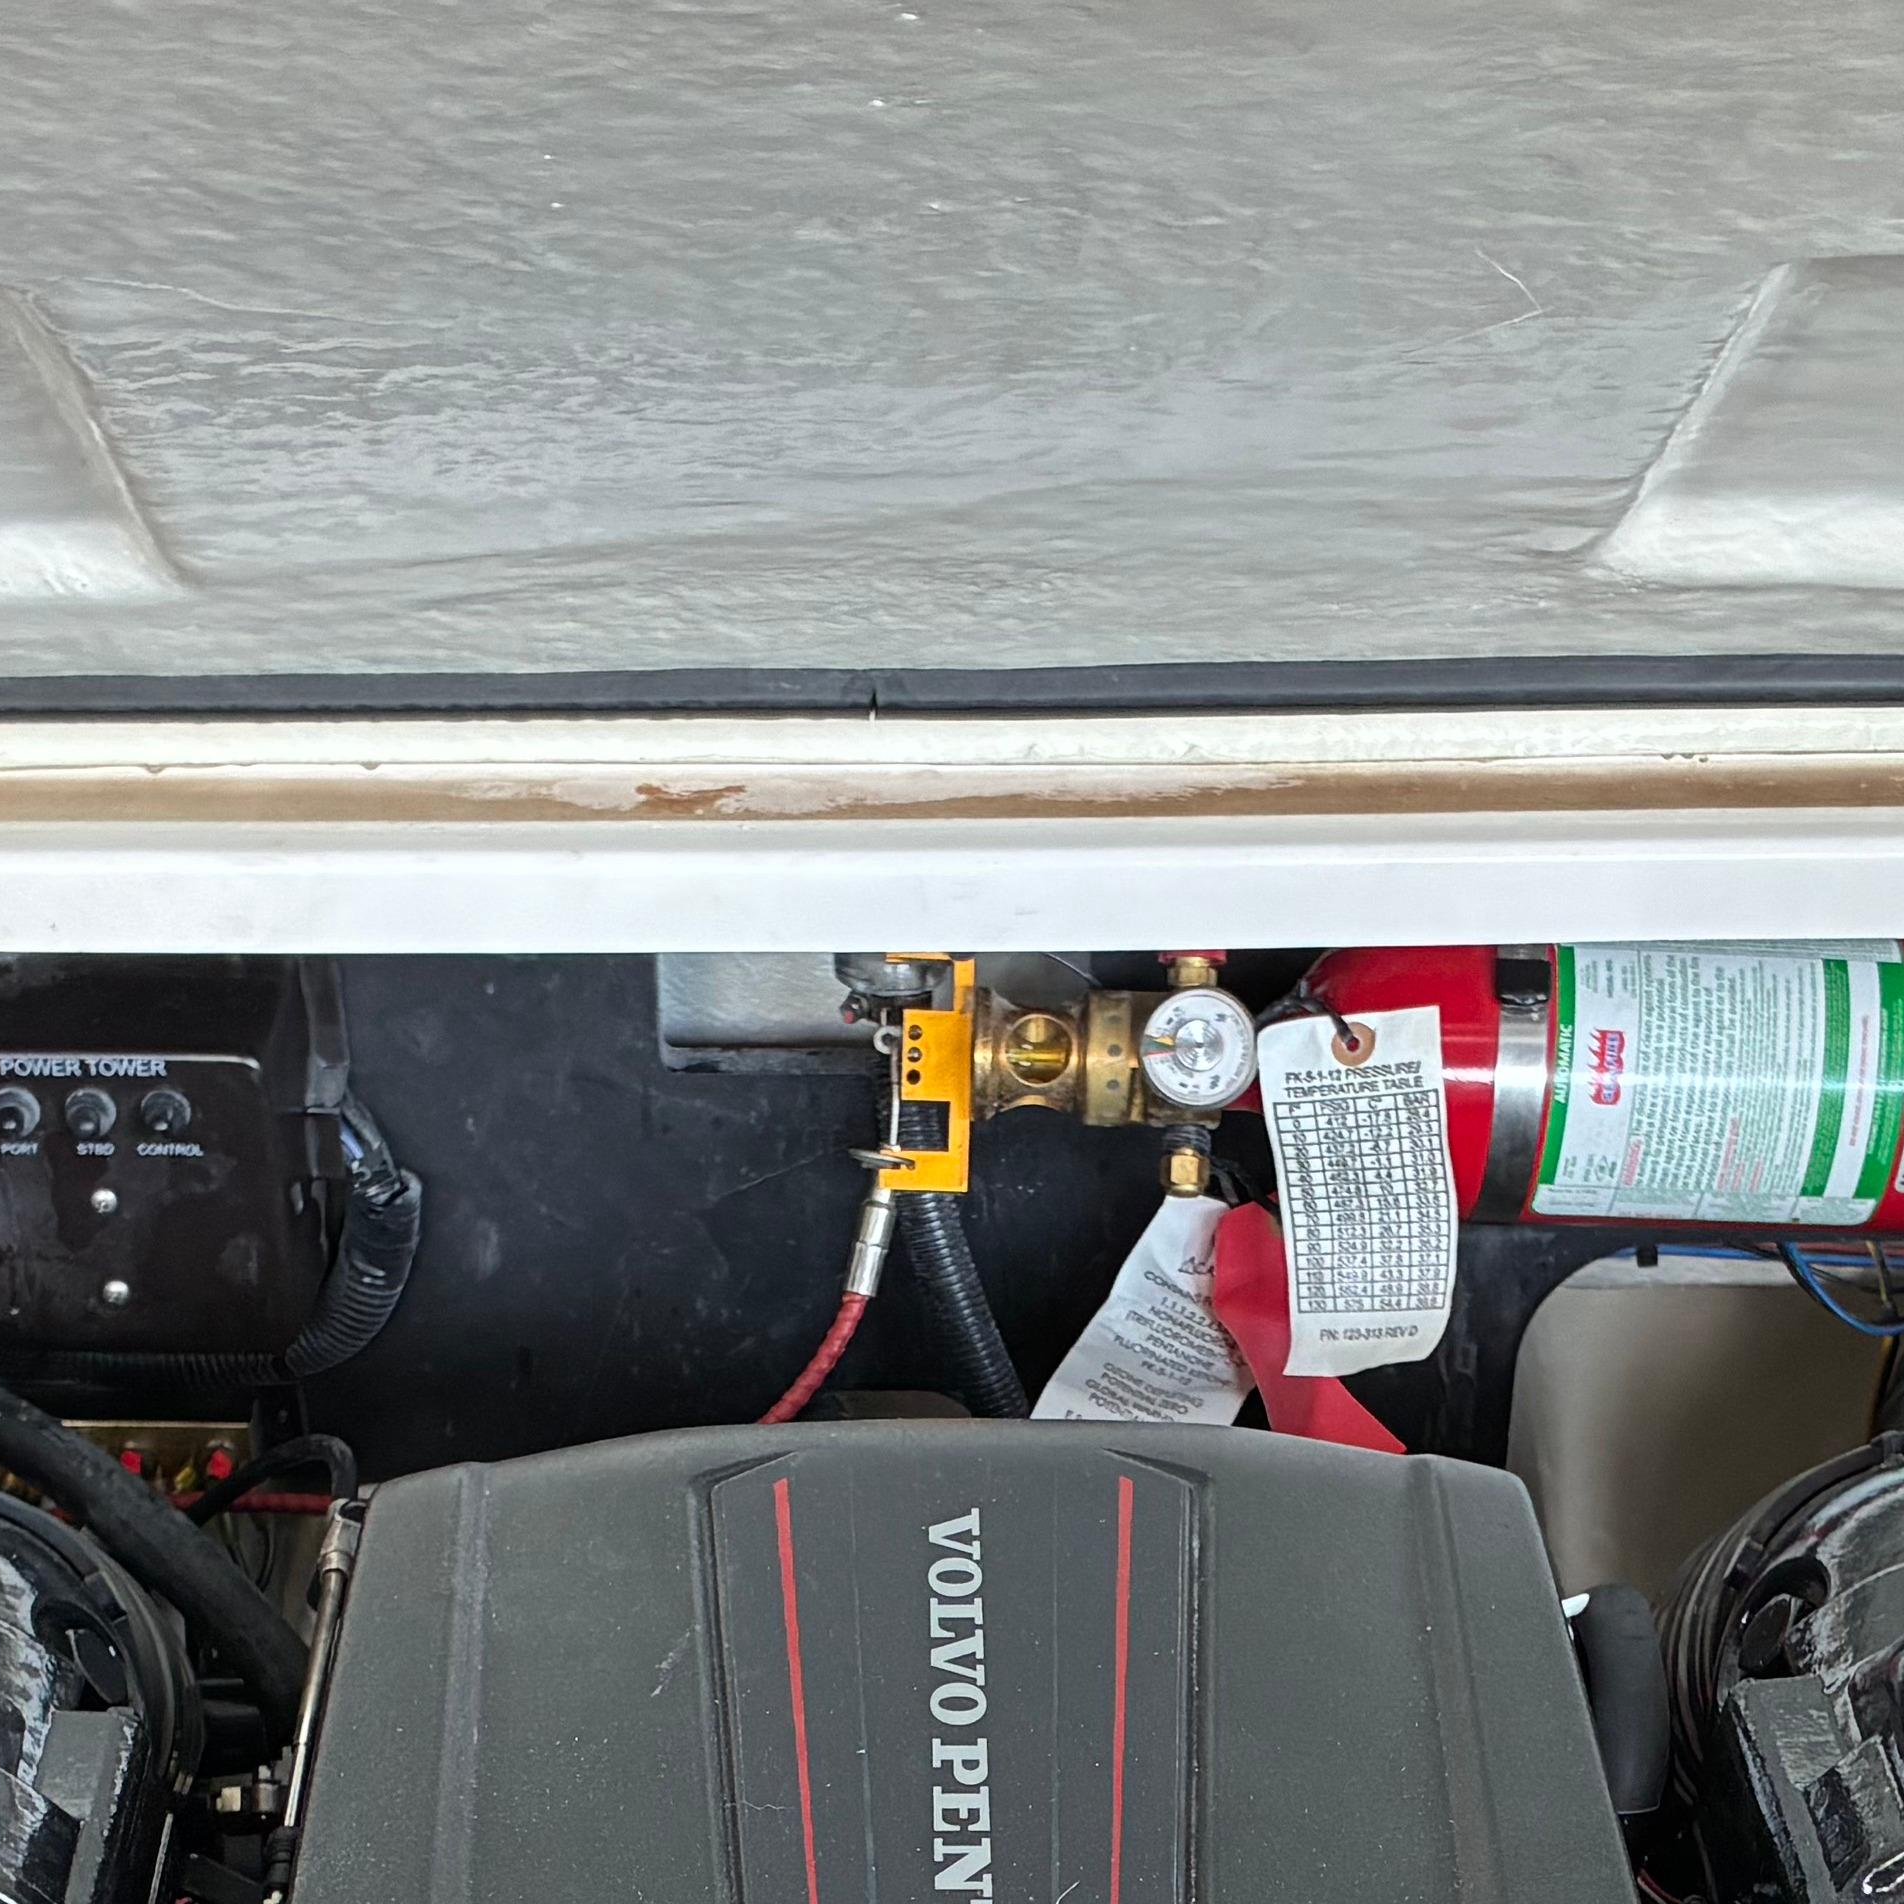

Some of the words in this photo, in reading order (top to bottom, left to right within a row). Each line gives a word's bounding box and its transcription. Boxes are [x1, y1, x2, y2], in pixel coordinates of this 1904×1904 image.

[0, 1058, 81, 1077] POWER
[85, 1059, 167, 1077] TOWER
[1554, 1023, 1572, 1103] AUTOMATIC
[1285, 1081, 1379, 1098] TEMPERATURE
[1383, 1076, 1423, 1090] TABLE
[0, 1143, 39, 1155] PORT
[76, 1143, 115, 1156] STBD
[136, 1144, 204, 1156] CONTROL
[921, 1507, 988, 1726] VOLVO
